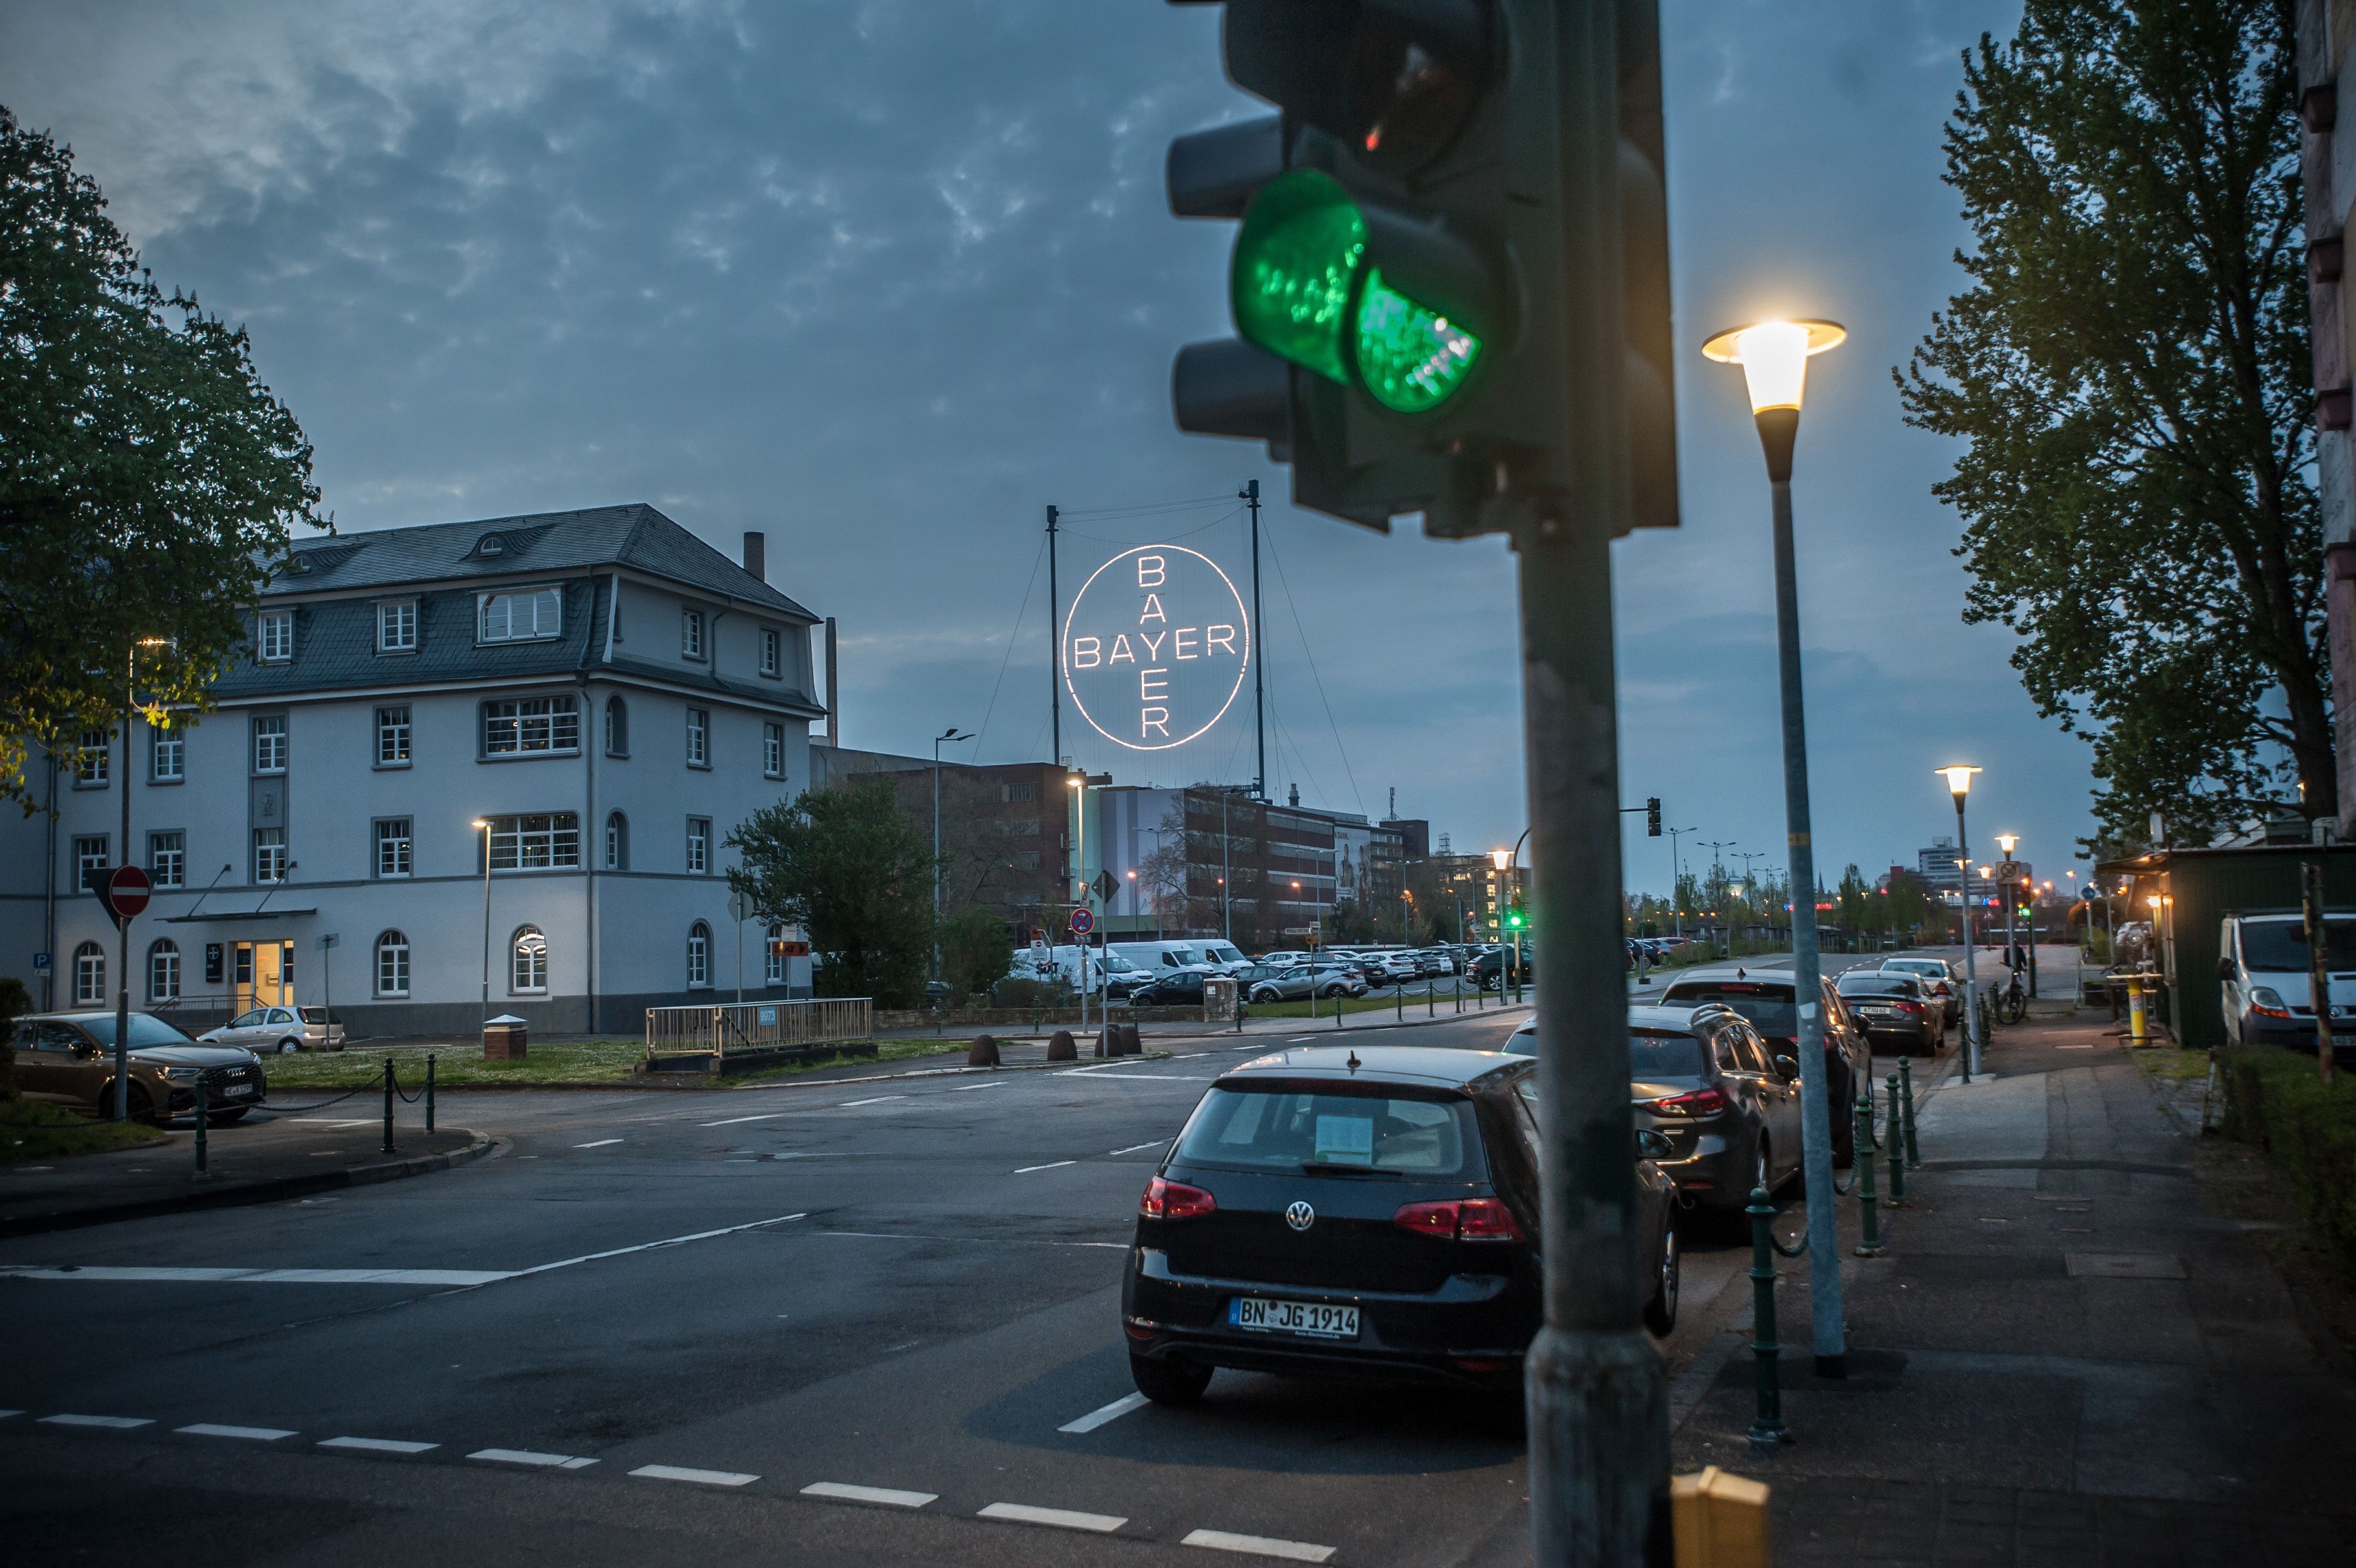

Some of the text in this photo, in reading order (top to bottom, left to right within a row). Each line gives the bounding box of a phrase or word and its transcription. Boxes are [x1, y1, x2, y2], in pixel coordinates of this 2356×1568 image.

[1074, 624, 1235, 668] BAYER
[1139, 555, 1169, 737] BAYER
[38, 955, 47, 966] P
[760, 1010, 775, 1021] 9973
[1286, 1201, 1314, 1230] VW
[1241, 1301, 1266, 1324] BN
[1279, 1304, 1305, 1328] JG
[1308, 1306, 1356, 1332] 1914
